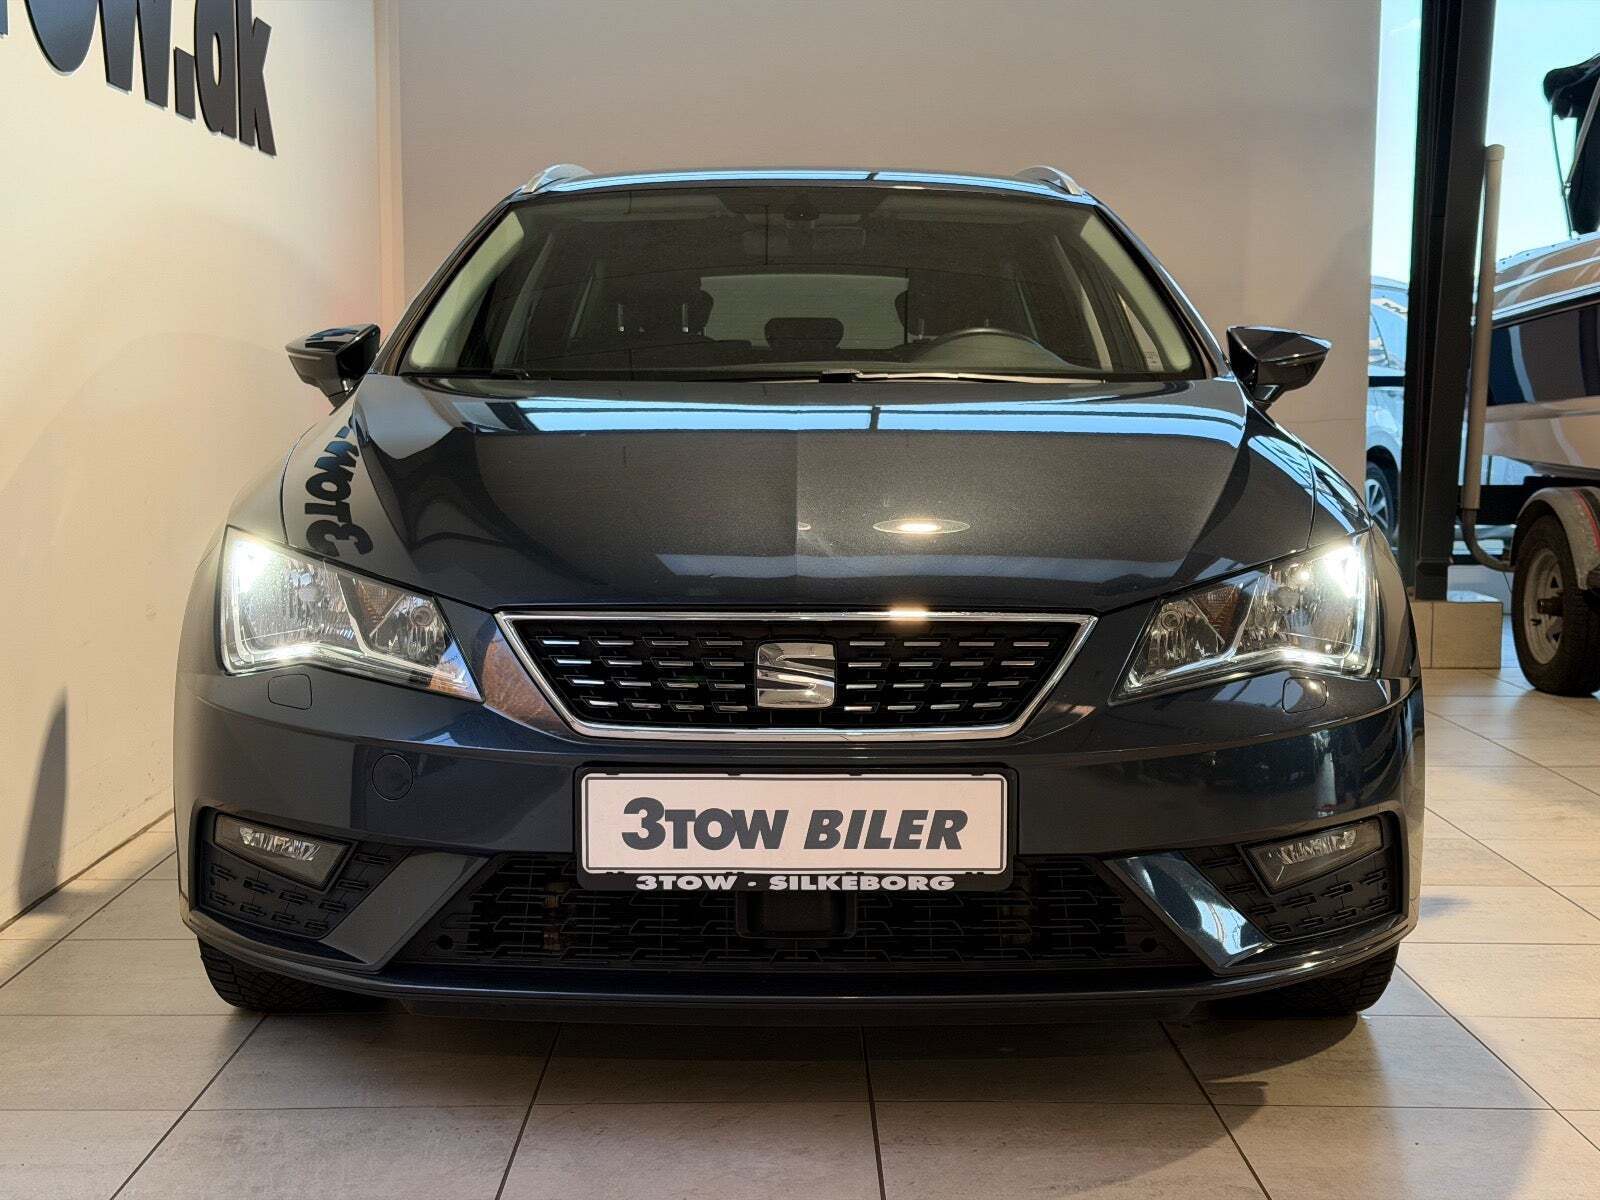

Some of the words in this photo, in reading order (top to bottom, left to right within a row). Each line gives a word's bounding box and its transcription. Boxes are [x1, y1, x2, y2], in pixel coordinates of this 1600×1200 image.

[621, 796, 790, 851] 3TOW
[803, 809, 969, 850] BILER
[635, 875, 738, 891] 3TOW
[769, 875, 955, 891] SILKEBORG
